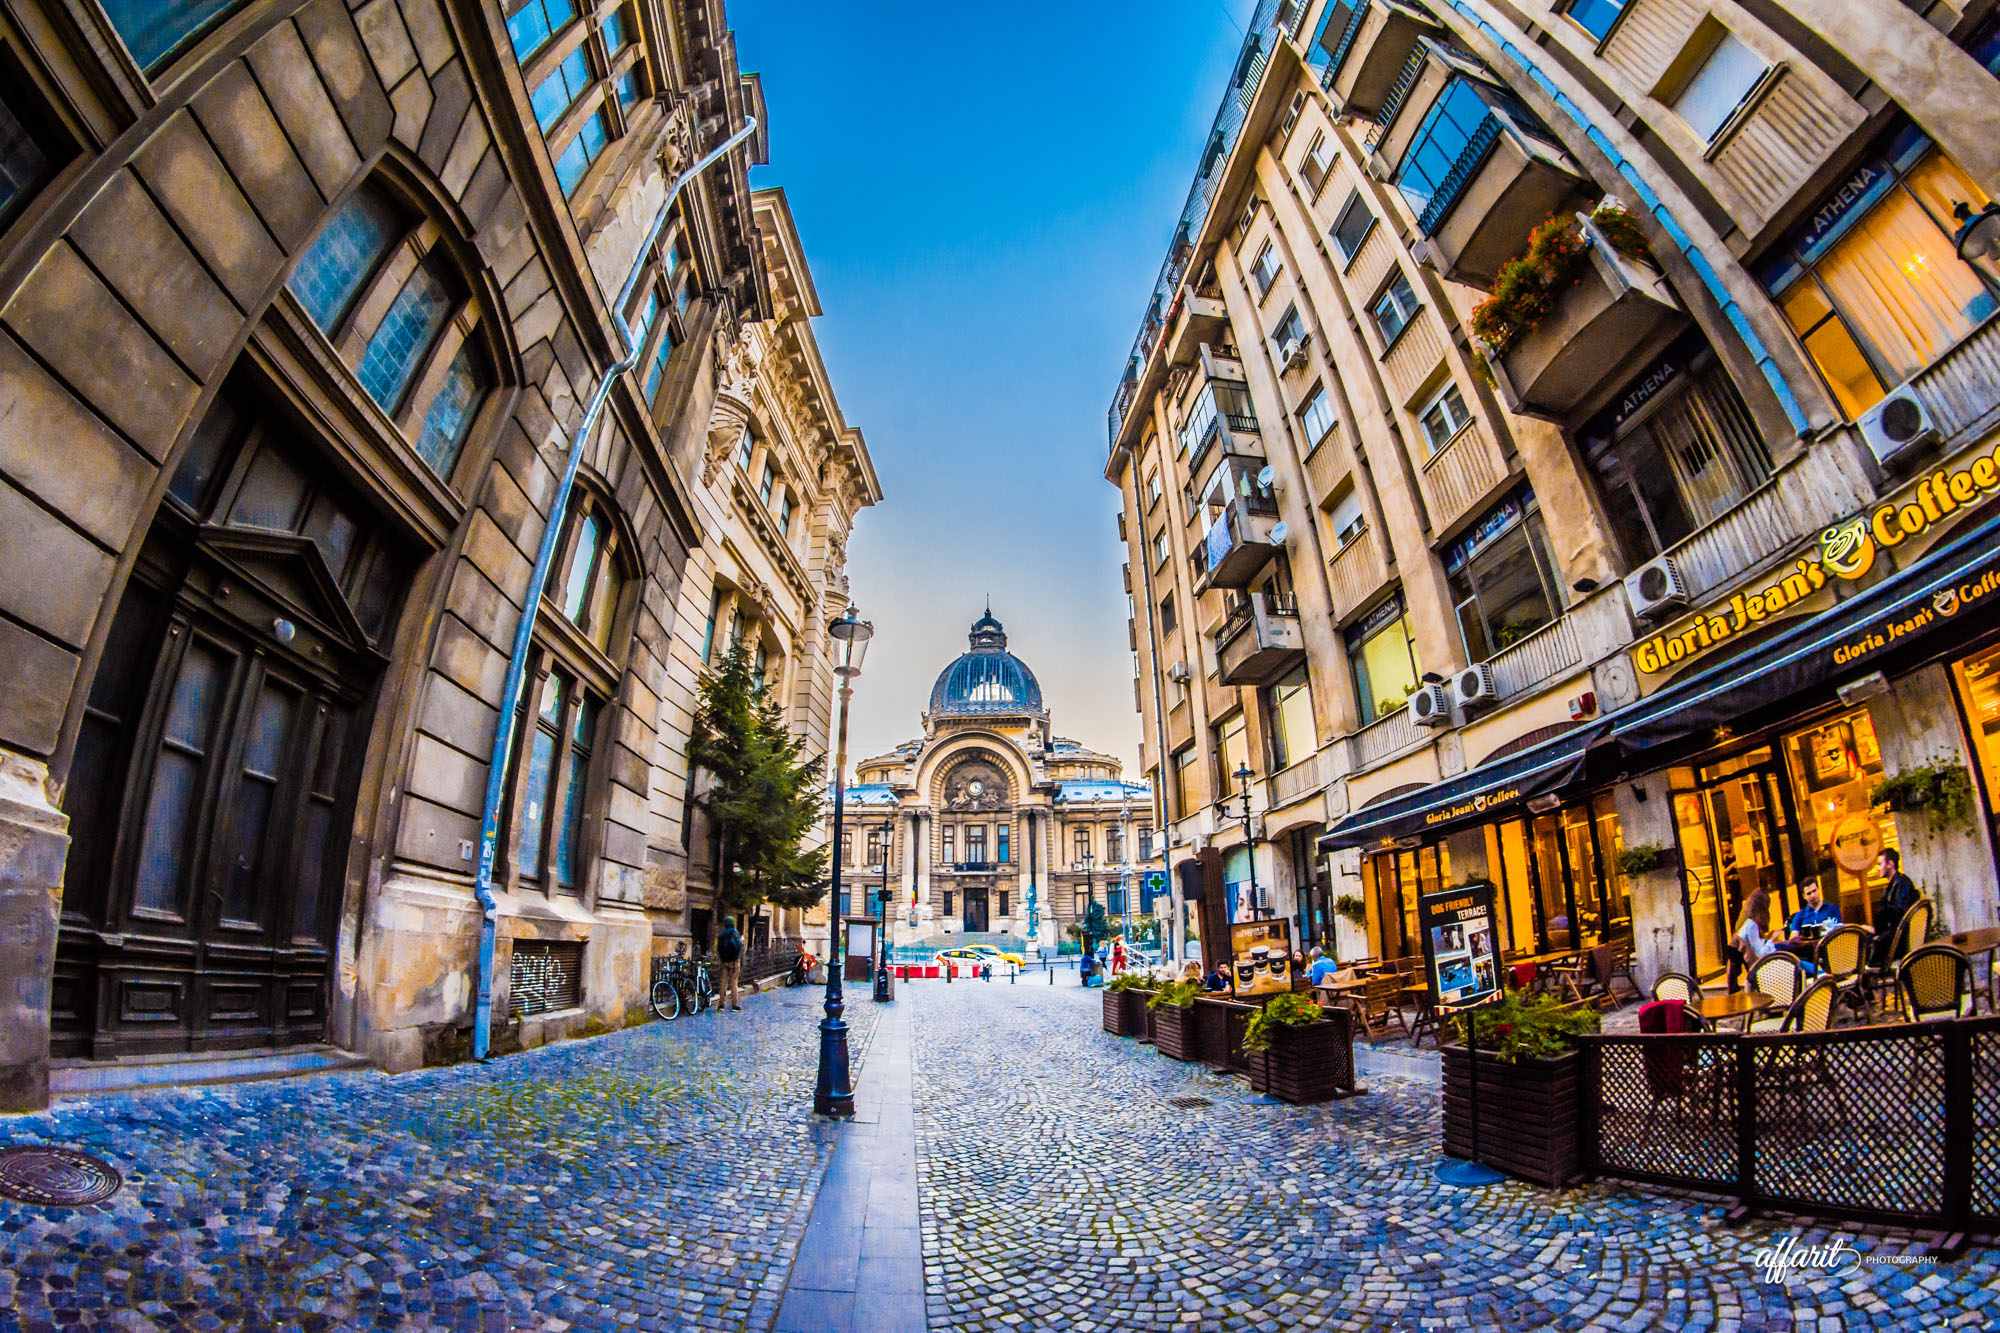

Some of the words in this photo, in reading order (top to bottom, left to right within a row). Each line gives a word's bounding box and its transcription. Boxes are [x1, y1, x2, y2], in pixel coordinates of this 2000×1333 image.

[1813, 167, 1876, 233] ATHENA
[1623, 363, 1675, 413] ATHENA
[1636, 613, 1731, 674] Gloria
[1729, 558, 1826, 632] Jean's
[1833, 633, 1885, 665] Gloria
[1887, 607, 1935, 642] Jean's
[1426, 810, 1451, 825] Gloria
